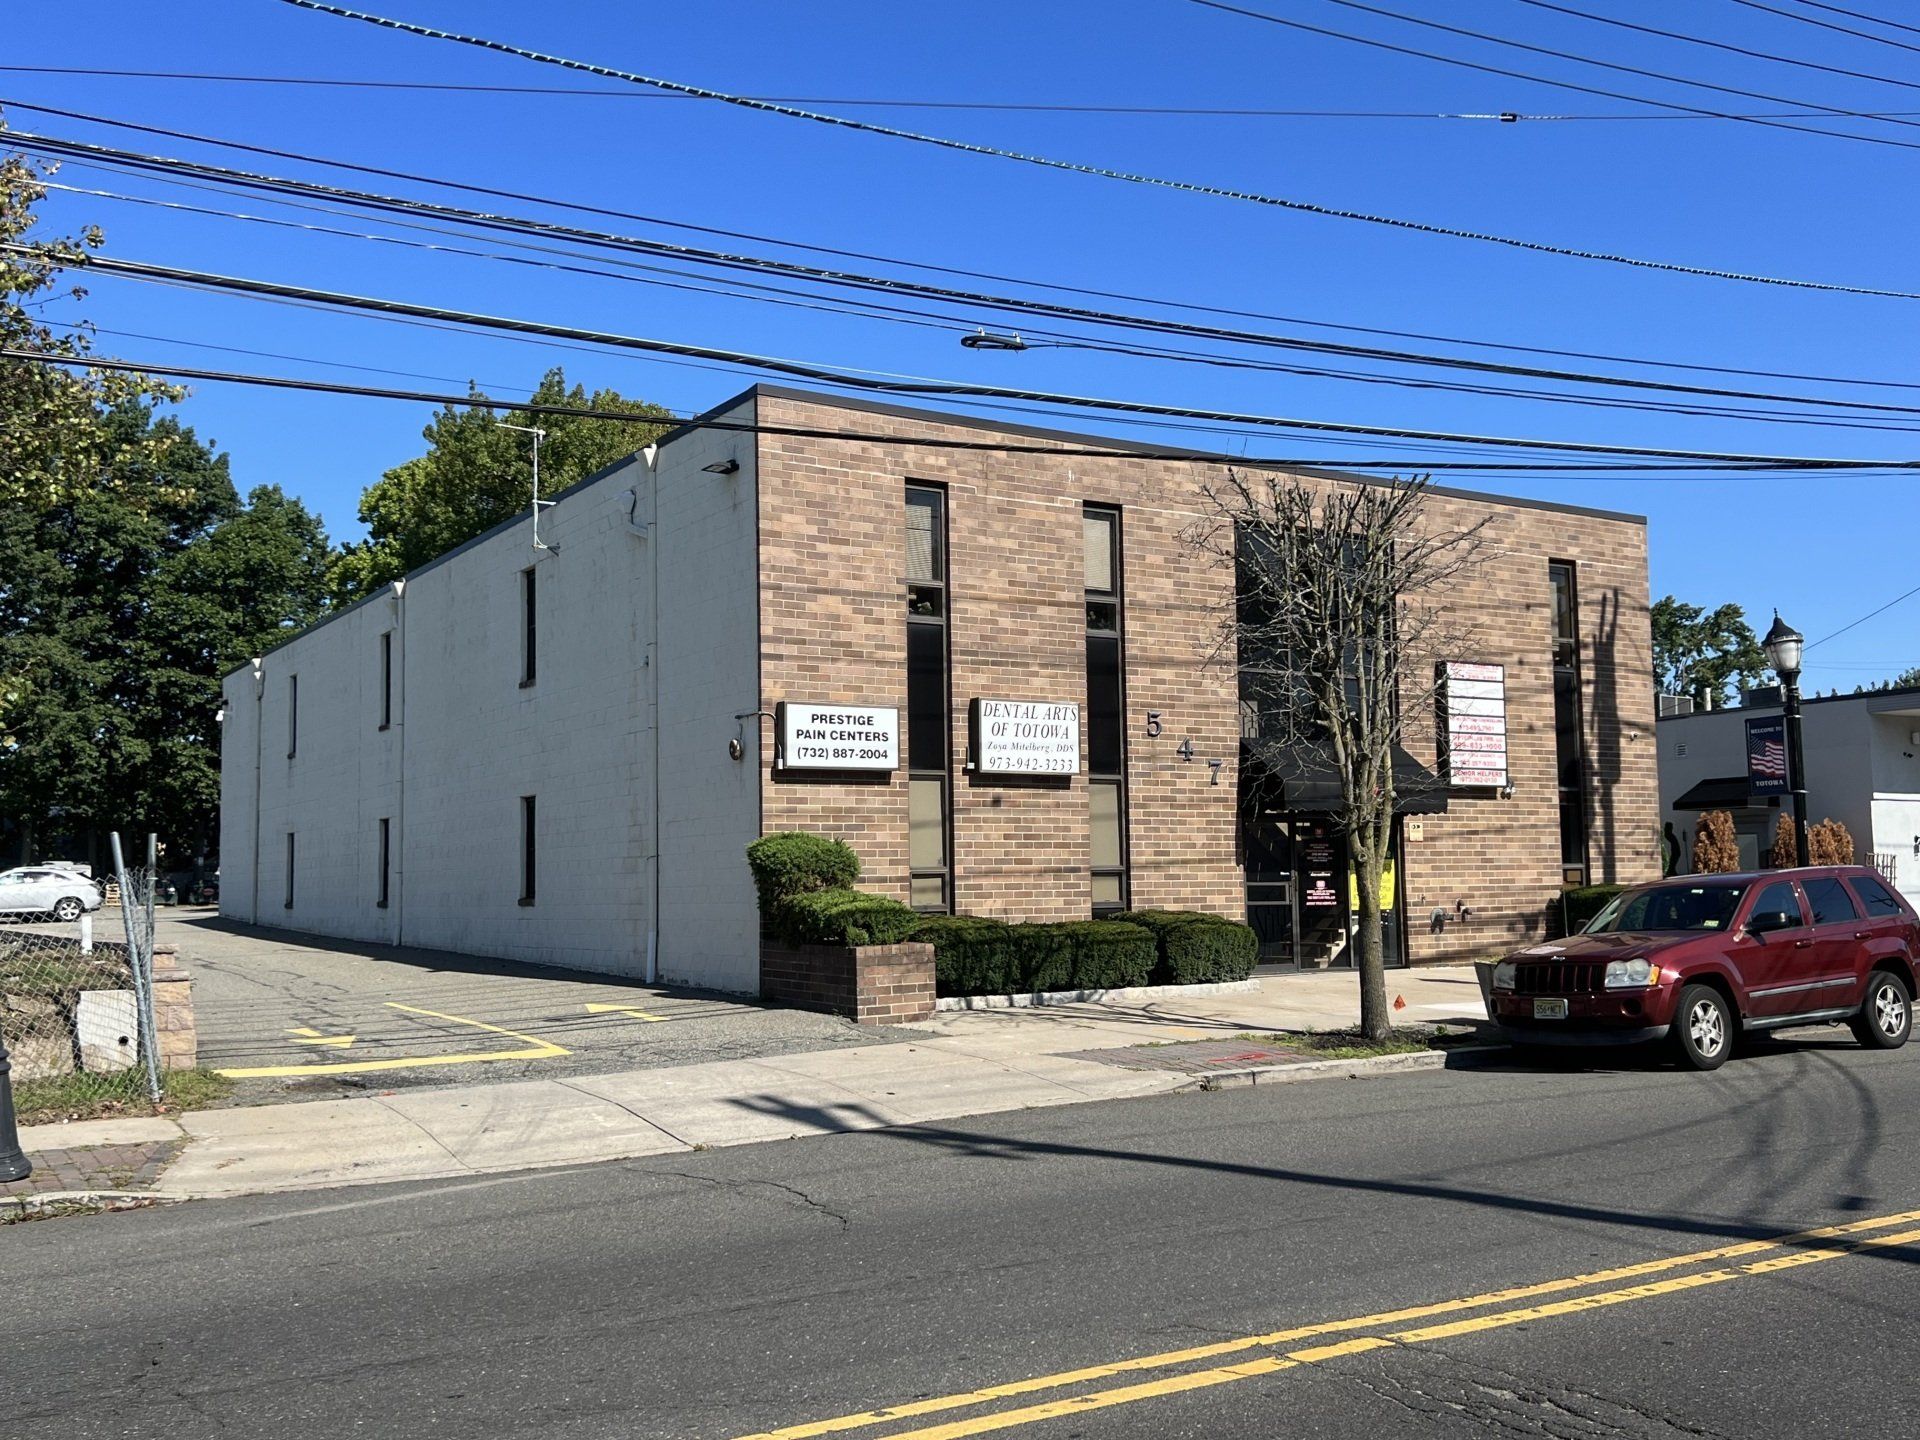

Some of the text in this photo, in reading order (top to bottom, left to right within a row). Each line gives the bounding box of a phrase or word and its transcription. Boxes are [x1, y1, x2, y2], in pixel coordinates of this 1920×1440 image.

[983, 703, 1077, 722] DENTAL ARTS
[811, 714, 874, 726] PRESTIGE
[796, 729, 889, 742] PAIN CENTERS
[991, 722, 1069, 740] OF TOTOWA
[797, 747, 888, 760] (732) 887-2004
[987, 742, 1007, 752] Zoya
[1056, 744, 1074, 753] DDS
[989, 756, 1073, 772] 973-942-3233
